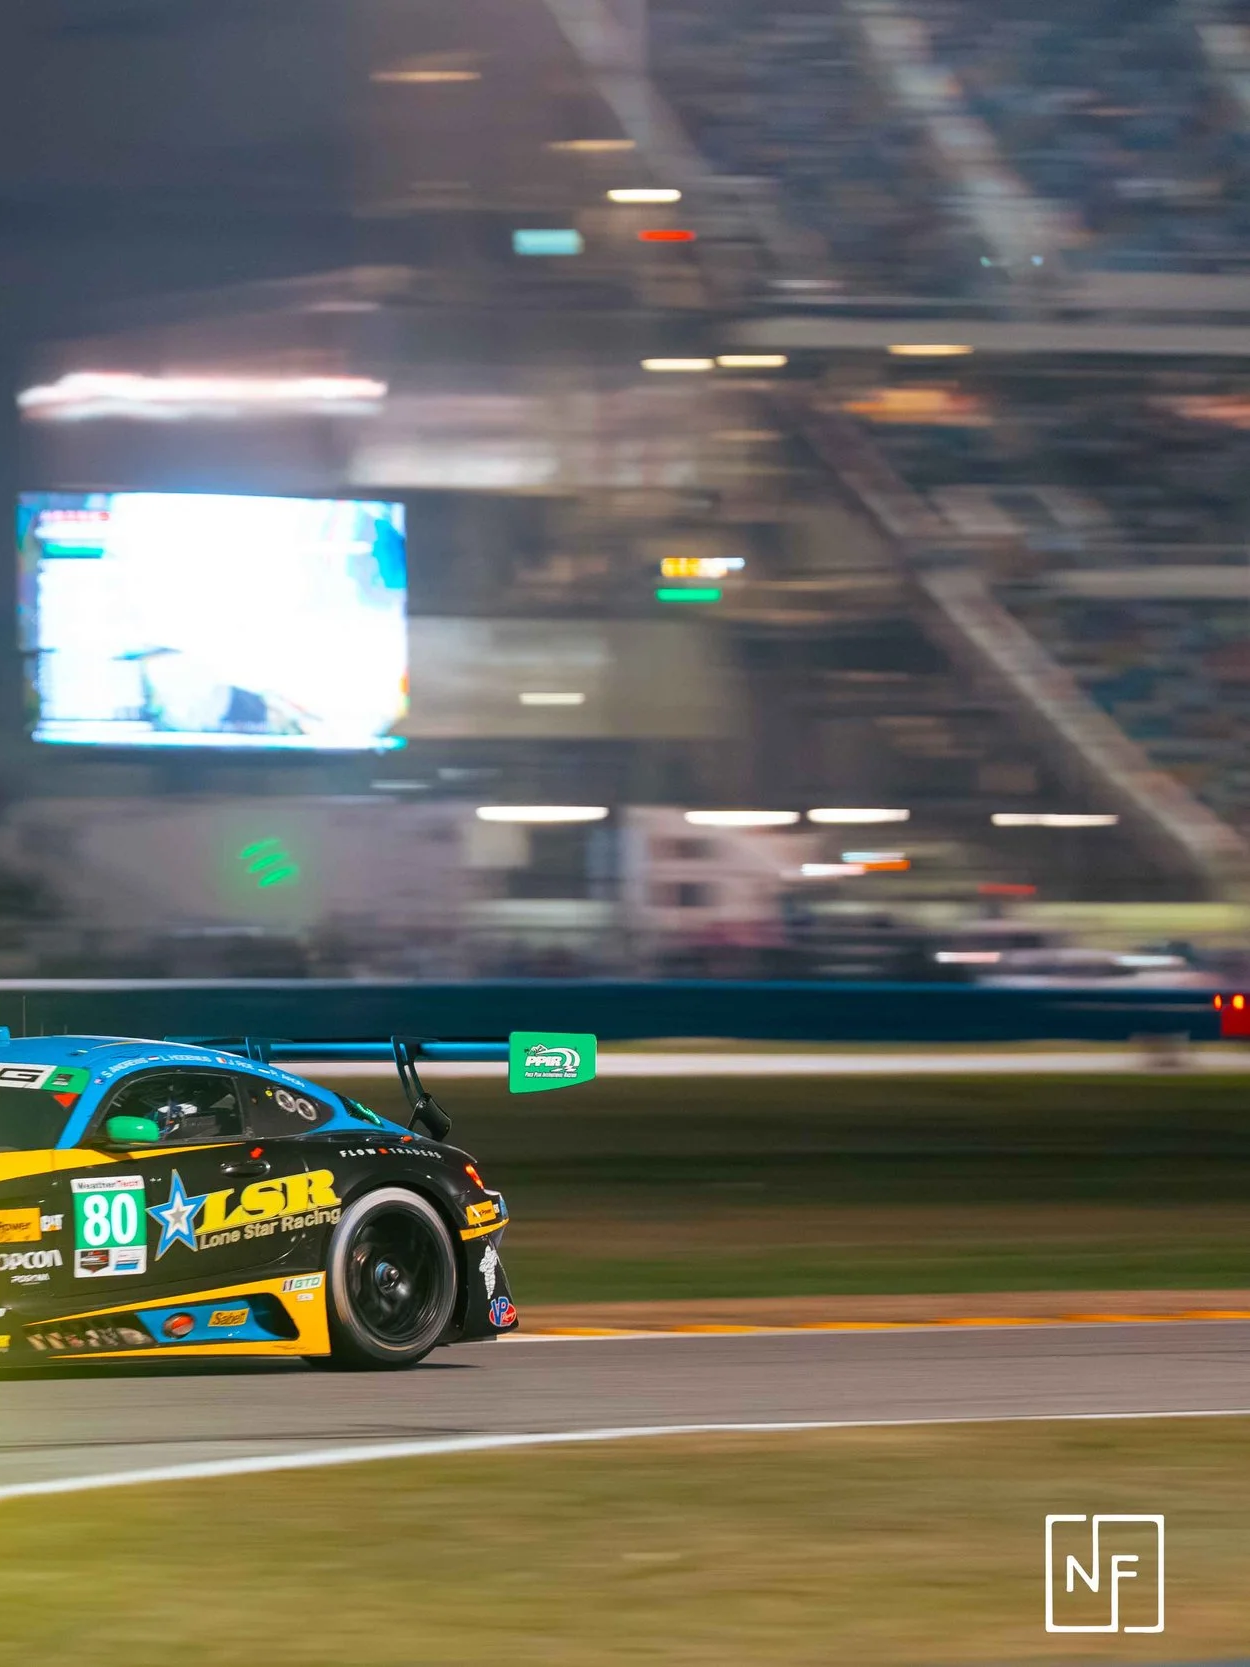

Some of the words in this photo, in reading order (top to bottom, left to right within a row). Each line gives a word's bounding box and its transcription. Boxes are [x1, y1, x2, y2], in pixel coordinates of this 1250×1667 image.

[339, 1149, 376, 1158] FLOW
[83, 1193, 138, 1246] 80
[195, 1169, 342, 1235] LSR
[200, 1229, 240, 1250] Lone
[244, 1221, 278, 1241] Star
[282, 1208, 341, 1233] Racing
[491, 1297, 509, 1325] VP
